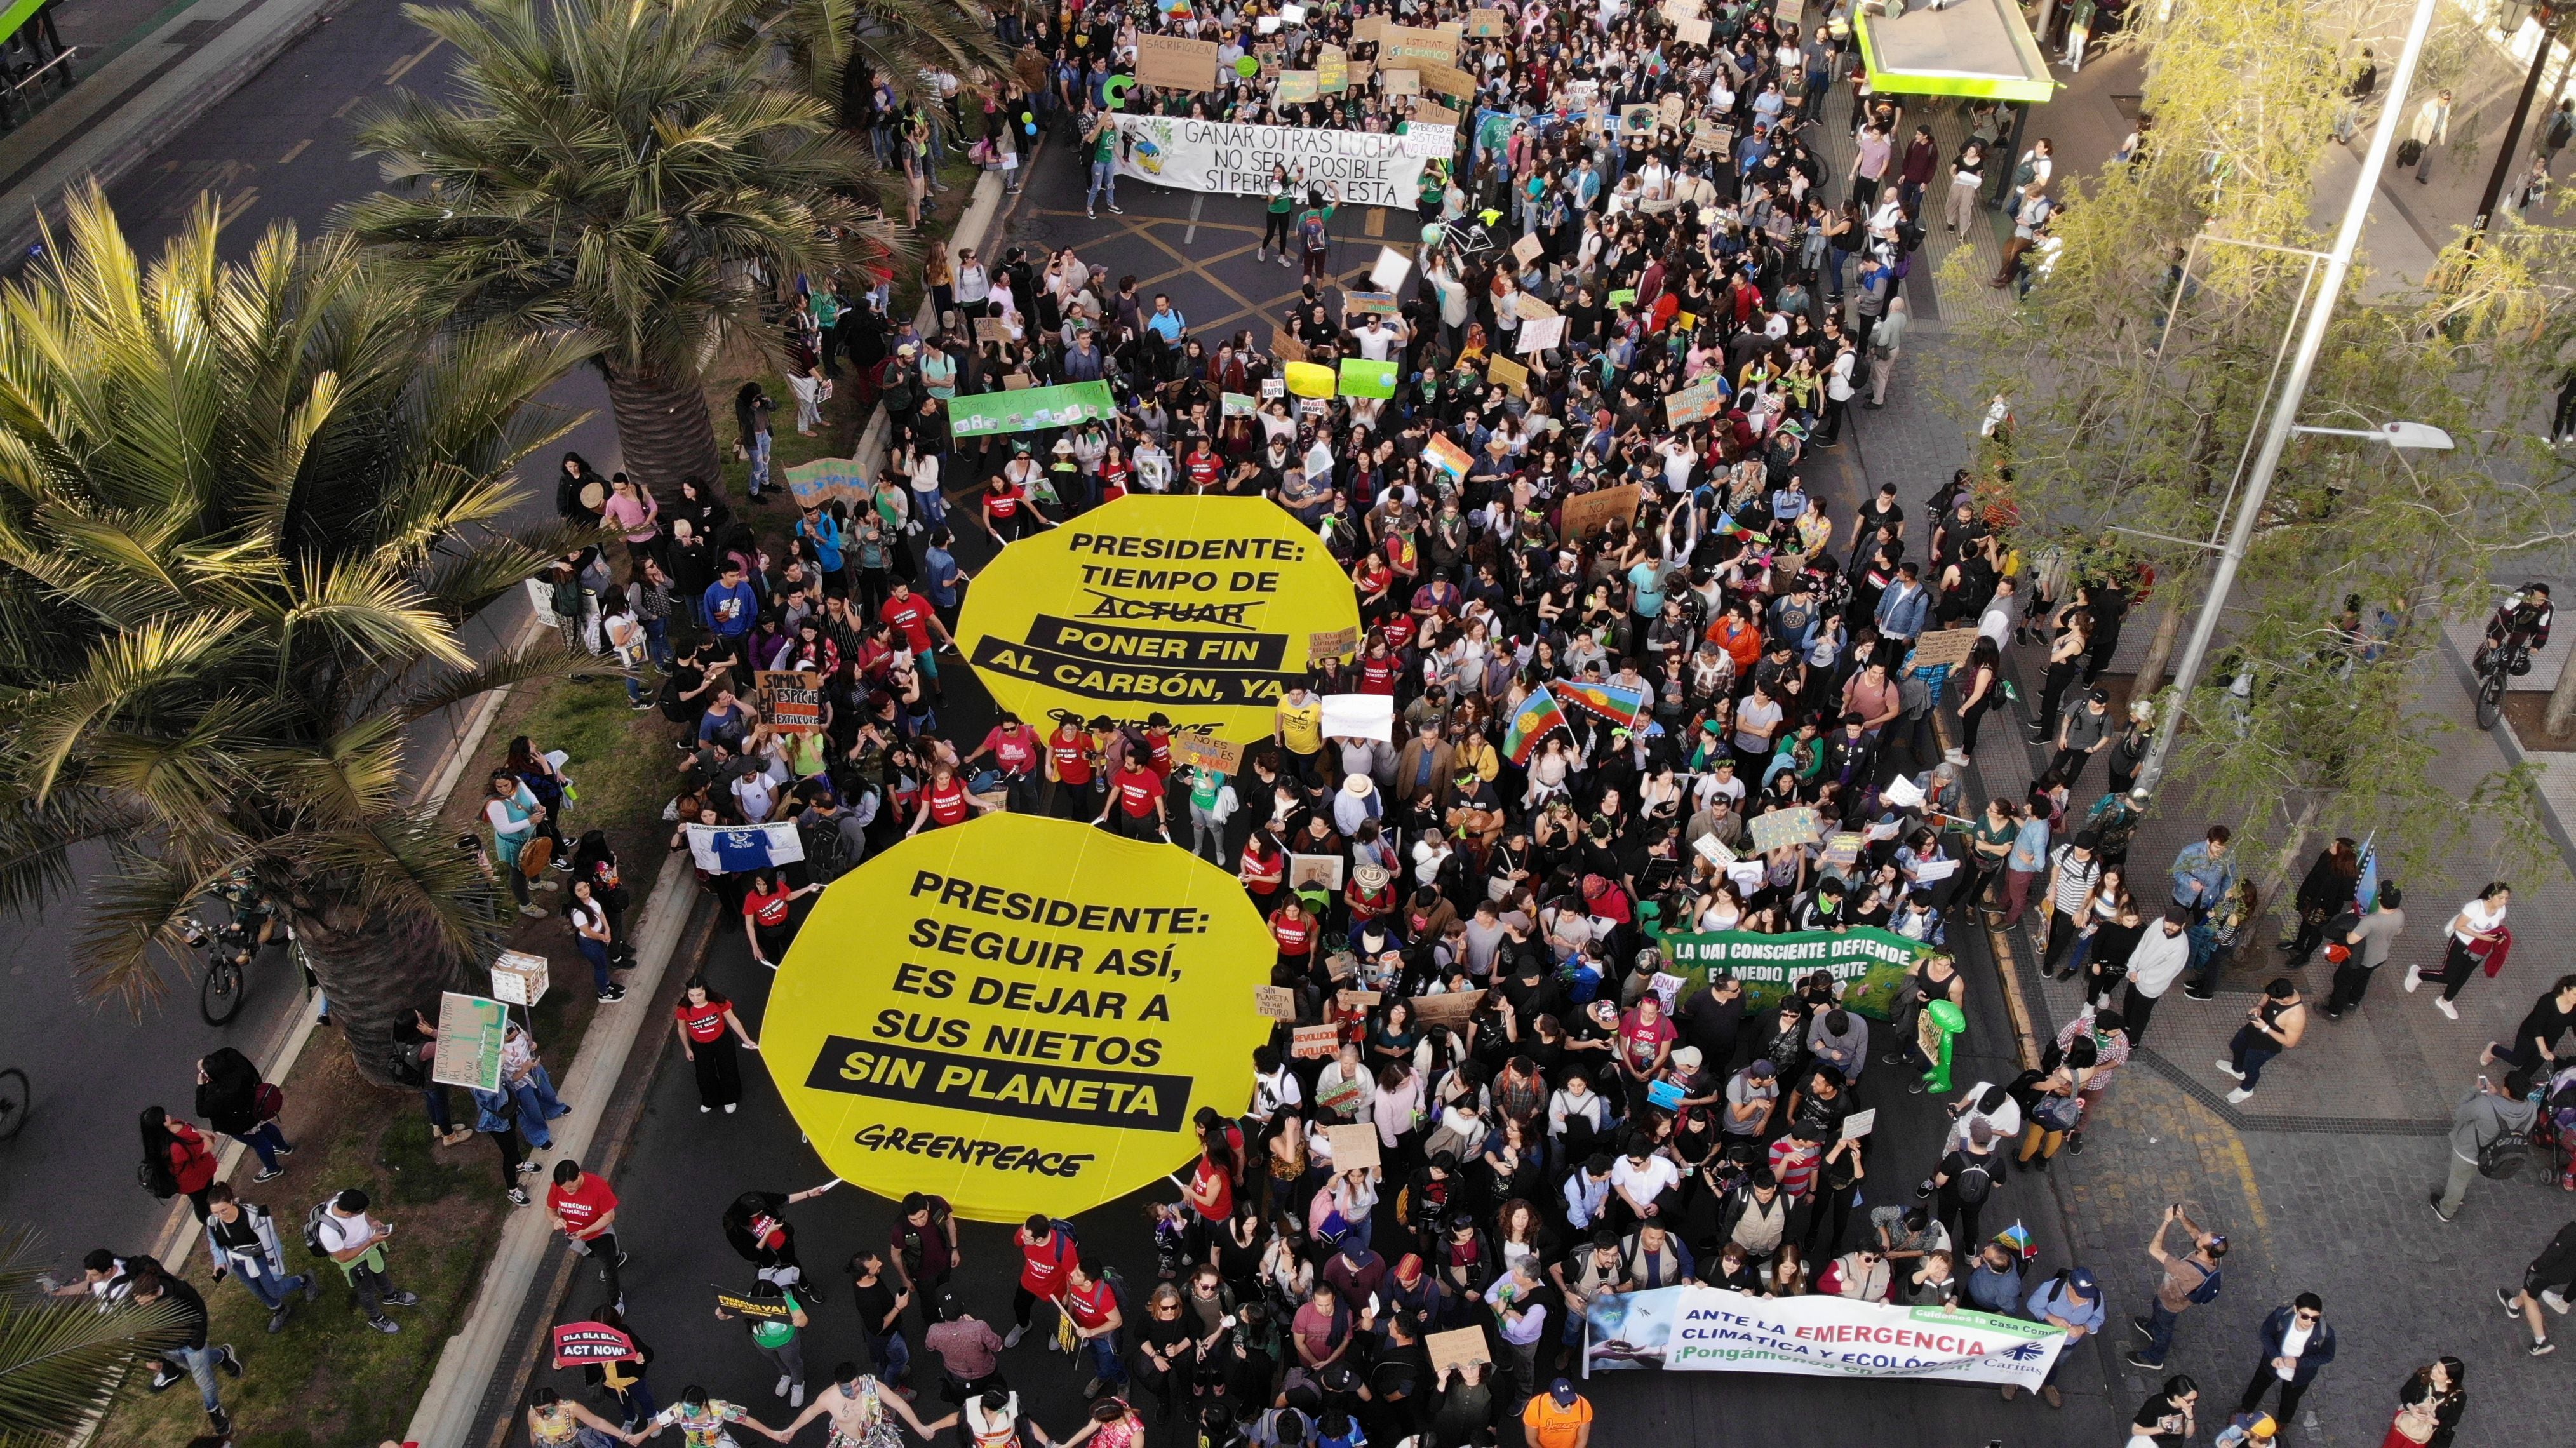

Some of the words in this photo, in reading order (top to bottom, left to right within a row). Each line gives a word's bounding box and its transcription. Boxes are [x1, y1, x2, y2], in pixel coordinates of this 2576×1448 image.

[1146, 39, 1212, 55] SACRIFIQUEN
[1185, 121, 1255, 147] GANAR
[1263, 129, 1332, 153] OTRAS
[1411, 132, 1451, 145] SISTEMA
[1494, 131, 1510, 141] 25
[1405, 144, 1419, 154] NO
[1421, 145, 1430, 154] EL
[1430, 145, 1452, 157] CLIMA
[1214, 149, 1243, 170] NO
[1309, 156, 1389, 180] POSIBLE
[1206, 170, 1224, 192] SI
[1346, 181, 1397, 205] ESTA
[1684, 384, 1711, 398] MUNDO
[1588, 502, 1604, 513] NO
[1068, 532, 1306, 563] PRESIDENTE:
[1080, 564, 1222, 593] TIEMPO
[1229, 571, 1280, 593] DE
[1090, 599, 1247, 625] ACTUAR
[1056, 626, 1187, 660] PONER
[1196, 639, 1261, 662] FIN
[762, 673, 806, 689] SOMOS
[989, 648, 1041, 676] AL
[1053, 664, 1225, 702] CARBÓN,
[1240, 677, 1285, 700] YA
[758, 688, 777, 702] LA
[777, 689, 818, 704] ESPECIE
[758, 702, 775, 714] EN
[761, 714, 775, 724] DE
[1194, 735, 1211, 746] NO
[1214, 740, 1228, 750] ES
[1003, 747, 1024, 756] Global
[1221, 749, 1234, 761] ES
[908, 869, 1210, 934] PRESIDENTE:
[908, 918, 1082, 973] SEGUIR
[1094, 942, 1183, 984] ASÍ,
[1675, 942, 1695, 960] LA
[1700, 943, 1726, 960] UAI
[1731, 942, 1827, 960] CONSCIENTE
[1831, 939, 1910, 966] DEFIENDE
[1731, 966, 1783, 982] MEDIO
[892, 963, 958, 1000] ES
[967, 975, 1129, 1021] DEJAR
[1139, 993, 1171, 1023] A
[1256, 993, 1289, 1002] PLANETA
[1263, 986, 1276, 995] SIN
[440, 998, 453, 1021] CAMBIO
[1259, 1006, 1289, 1016] FUTURO
[442, 1024, 451, 1032] UN
[871, 1009, 971, 1050] SUS
[982, 1024, 1163, 1068] NIETOS
[1294, 1030, 1338, 1043] REVOLUCION
[436, 1034, 451, 1078] NECESITAMOS
[1298, 1043, 1339, 1057] EVOLUCION
[448, 1069, 460, 1080] DEL
[839, 1051, 929, 1089] SIN
[934, 1063, 1160, 1117] PLANETA
[1316, 1092, 1329, 1103] WE
[1329, 1085, 1346, 1097] WILL
[1345, 1080, 1357, 1090] BE
[1335, 1101, 1353, 1113] YOU
[854, 1123, 1095, 1179] GREENPEACE
[762, 1305, 787, 1314] YA!
[1915, 1308, 1972, 1322] Cuidemos
[1975, 1316, 1986, 1324] la
[1990, 1318, 2019, 1331] Casa
[1685, 1310, 1750, 1327] ANTE
[1757, 1320, 1786, 1336] LA
[1794, 1324, 1986, 1357] EMERGENCIA
[563, 1345, 590, 1355] ACT
[593, 1346, 627, 1356] NOW!
[1682, 1327, 1809, 1355] CLIMÁTICA
[1819, 1349, 1836, 1358] Y
[1675, 1346, 1835, 1369] ¡Pongámonos
[1844, 1363, 1874, 1375] en
[1983, 1357, 2043, 1376] Caritas
